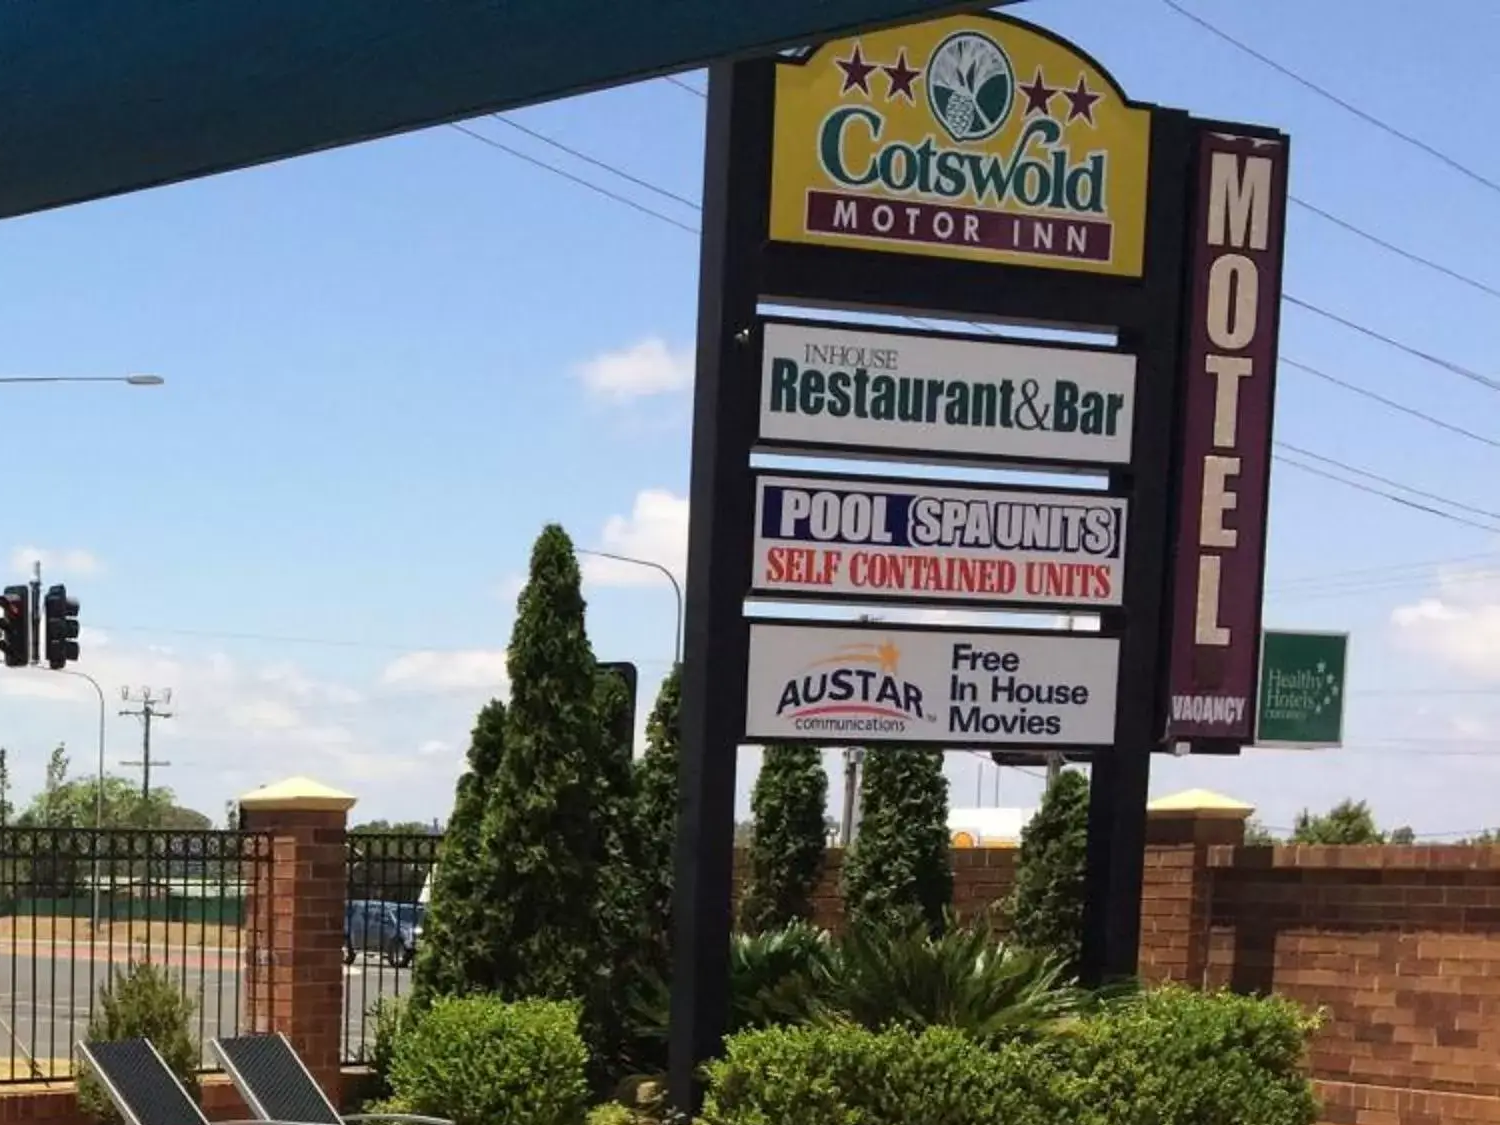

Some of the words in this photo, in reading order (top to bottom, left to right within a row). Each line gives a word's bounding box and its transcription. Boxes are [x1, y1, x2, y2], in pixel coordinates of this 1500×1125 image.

[819, 107, 1105, 213] Cotswold
[832, 200, 980, 243] MOTOR
[1012, 220, 1088, 254] INN
[803, 343, 899, 371] INHOUSE
[1195, 152, 1273, 646] MOTEL
[780, 489, 893, 543] POOL
[765, 546, 842, 586] SELF
[850, 550, 1017, 595] CONTAINED
[1024, 560, 1111, 599] UNITS
[951, 644, 1020, 673] Free
[776, 668, 923, 718] AUSTAR
[950, 674, 978, 702] In
[991, 675, 1089, 705] House
[795, 717, 905, 732] communications
[949, 706, 1061, 735] Movies
[1171, 695, 1246, 725] VACANCY
